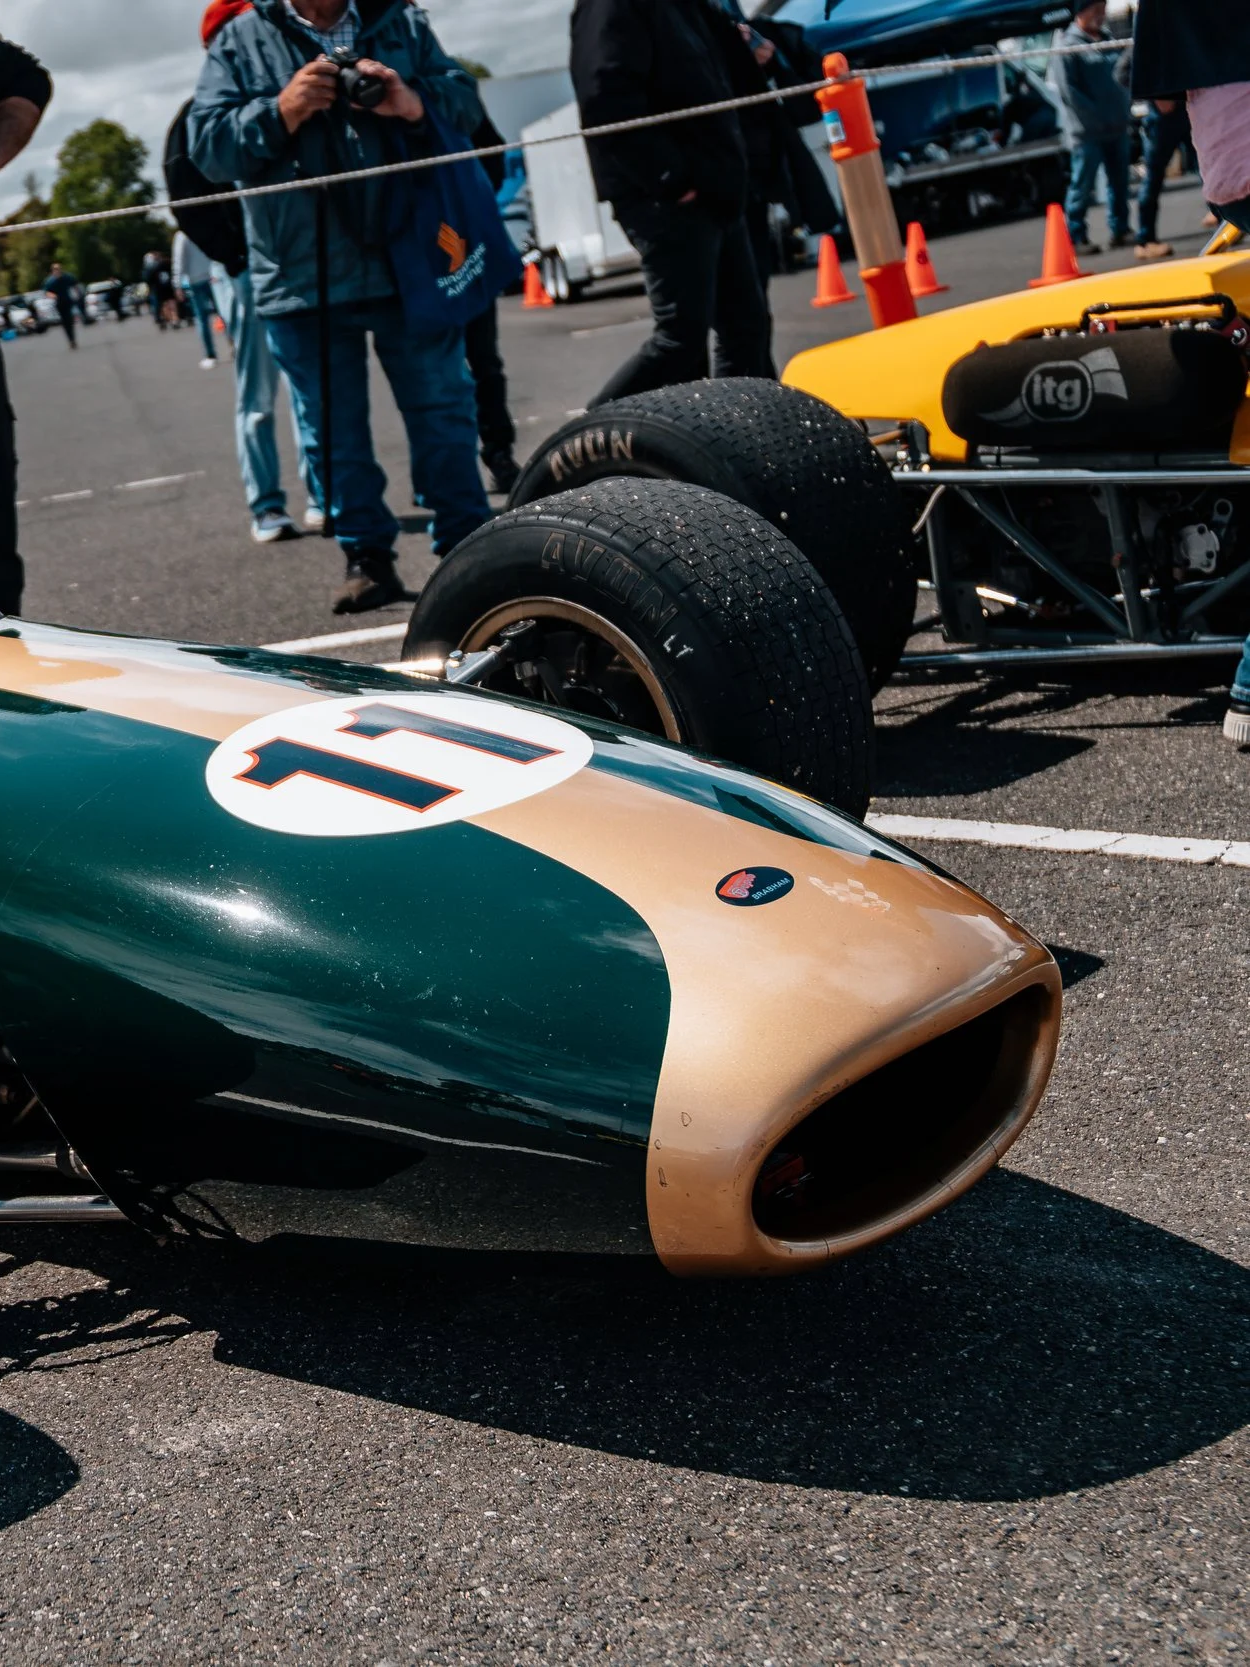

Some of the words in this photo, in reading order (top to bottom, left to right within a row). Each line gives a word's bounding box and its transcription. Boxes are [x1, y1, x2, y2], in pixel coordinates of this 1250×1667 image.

[1032, 373, 1081, 411] itg
[550, 430, 634, 482] AVON
[541, 532, 678, 637] AVON
[233, 702, 565, 813] 11
[751, 877, 791, 900] BRABHAM
